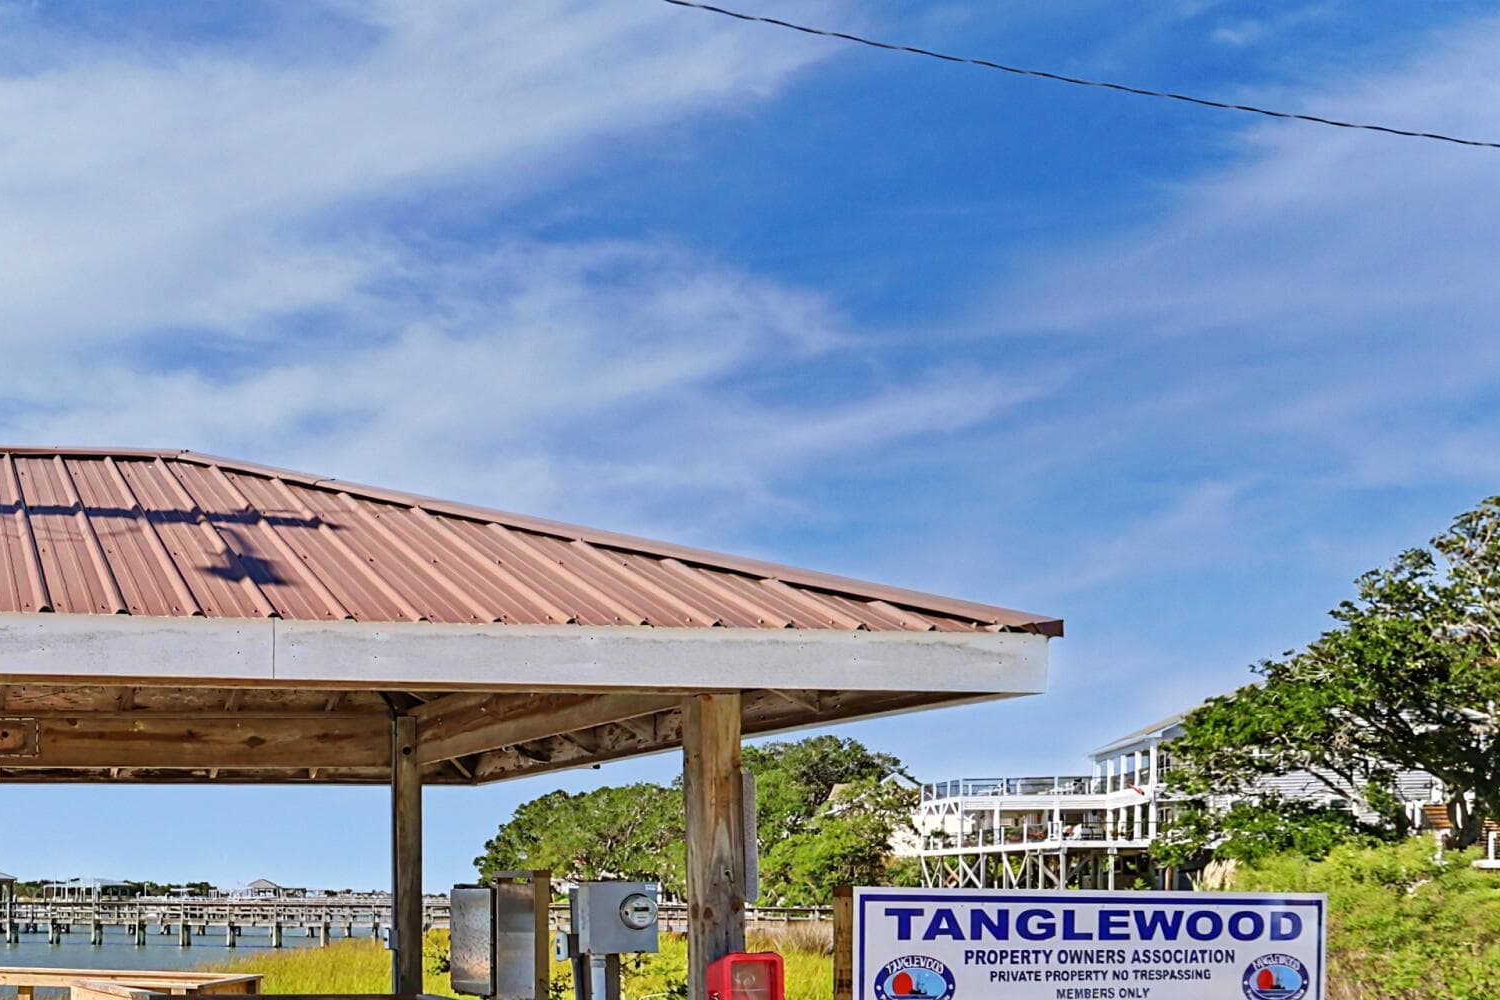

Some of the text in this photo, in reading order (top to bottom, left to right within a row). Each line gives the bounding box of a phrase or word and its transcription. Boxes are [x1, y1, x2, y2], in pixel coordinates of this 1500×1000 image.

[884, 908, 1302, 942] TANGLEWOOD
[964, 949, 1236, 965] PROPERTY OWNERS ASSOCIATION
[990, 969, 1211, 982] PRIVATE PROPERTY NO TRESPASSING
[1056, 988, 1150, 1000] MEMBERS ONLY
